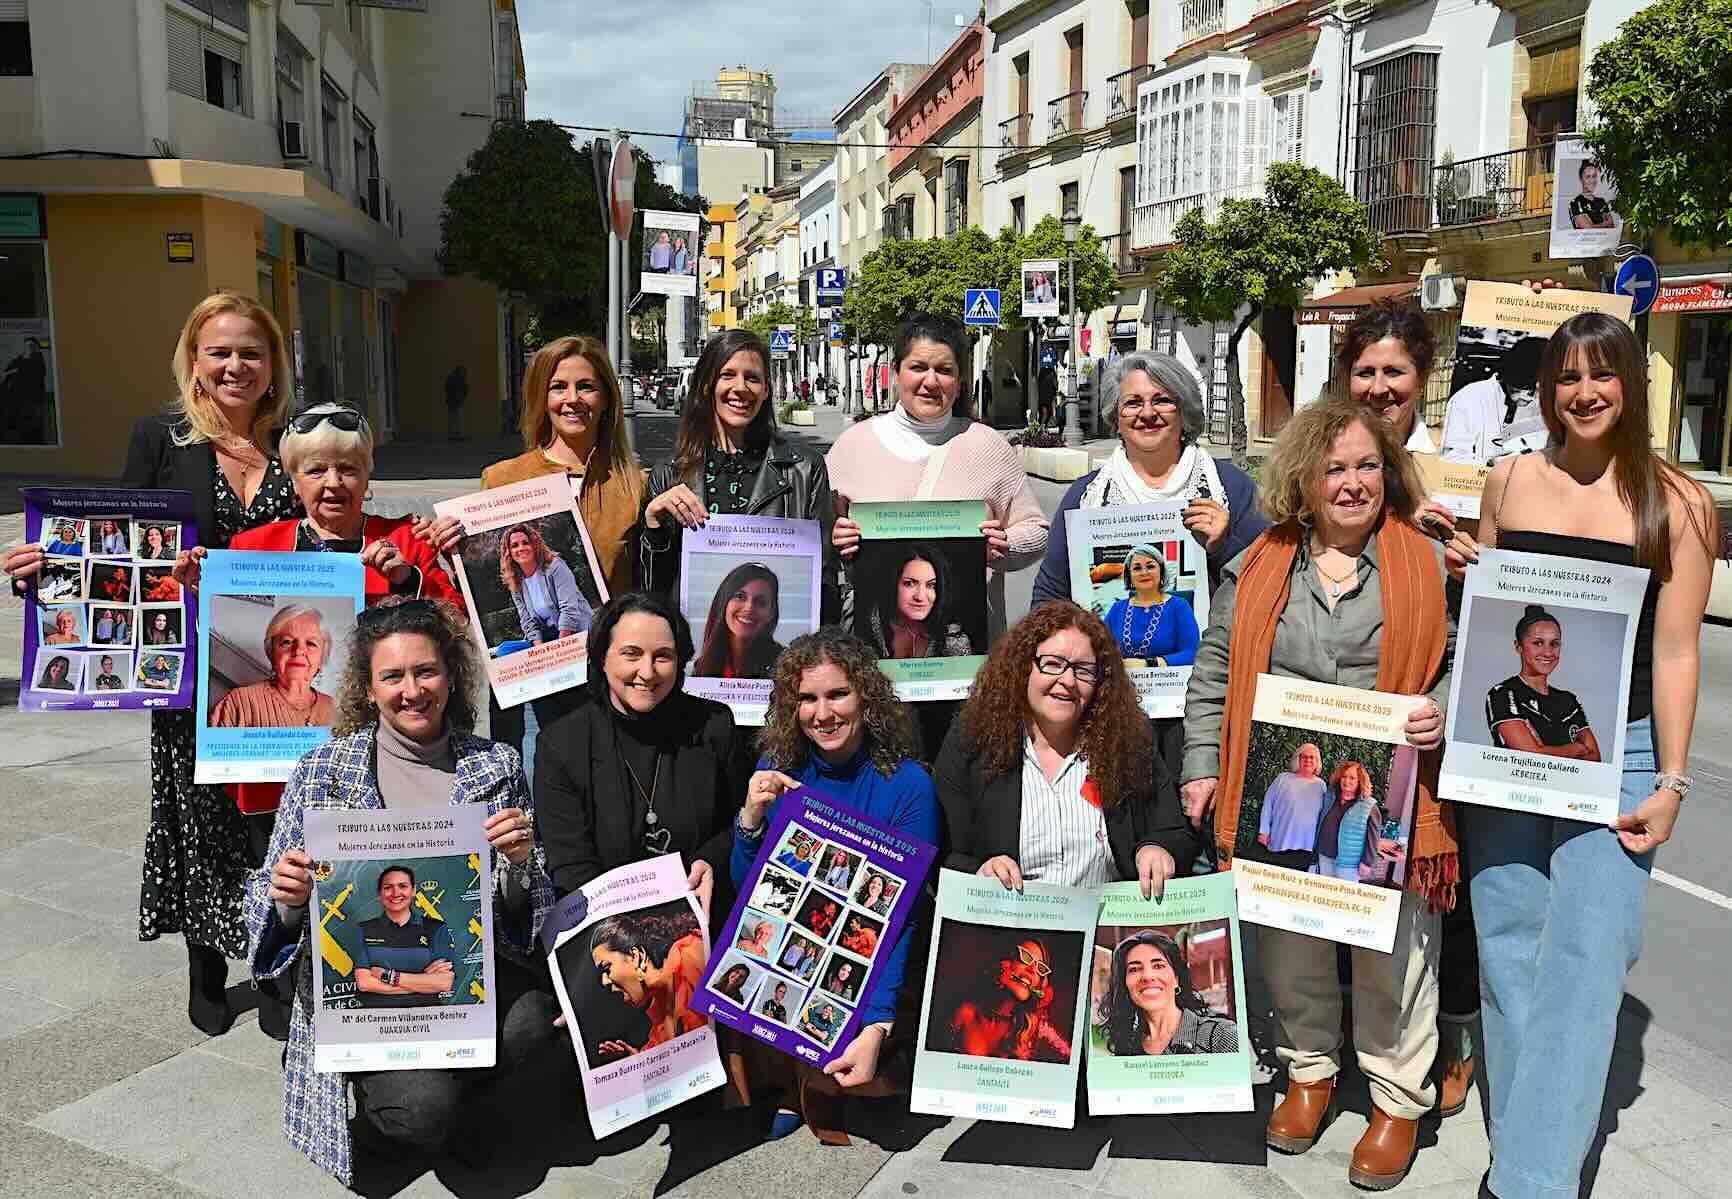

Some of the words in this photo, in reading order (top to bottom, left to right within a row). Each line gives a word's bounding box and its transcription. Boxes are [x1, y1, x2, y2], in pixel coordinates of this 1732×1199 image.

[823, 270, 838, 288] P
[1500, 563, 1530, 576] TRIBUTO
[1538, 567, 1552, 579] LAS
[1552, 570, 1591, 584] NUESTRAS
[1482, 751, 1509, 764] Lorena
[1547, 761, 1580, 774] Gallardo
[337, 823, 368, 833] TRIBUTO
[377, 823, 391, 833] LAS
[393, 821, 432, 832] NUESTRAS
[802, 796, 833, 817] TRIBUTO
[841, 813, 857, 827] LAS
[856, 820, 896, 844] NUESTRAS
[895, 838, 918, 856] 2025
[804, 809, 830, 828] Mujeres
[830, 819, 862, 843] jerezanas
[878, 843, 905, 862] historia
[338, 842, 367, 852] Mujeres
[368, 840, 405, 851] Jerezanas
[406, 841, 416, 849] en
[417, 838, 424, 848] la
[606, 875, 640, 890] NUESTRAS
[334, 1001, 346, 1009] de
[355, 1014, 366, 1023] del
[367, 1014, 397, 1023] Carmen
[398, 1012, 438, 1023] Villanueva
[412, 1025, 430, 1034] CIVIL
